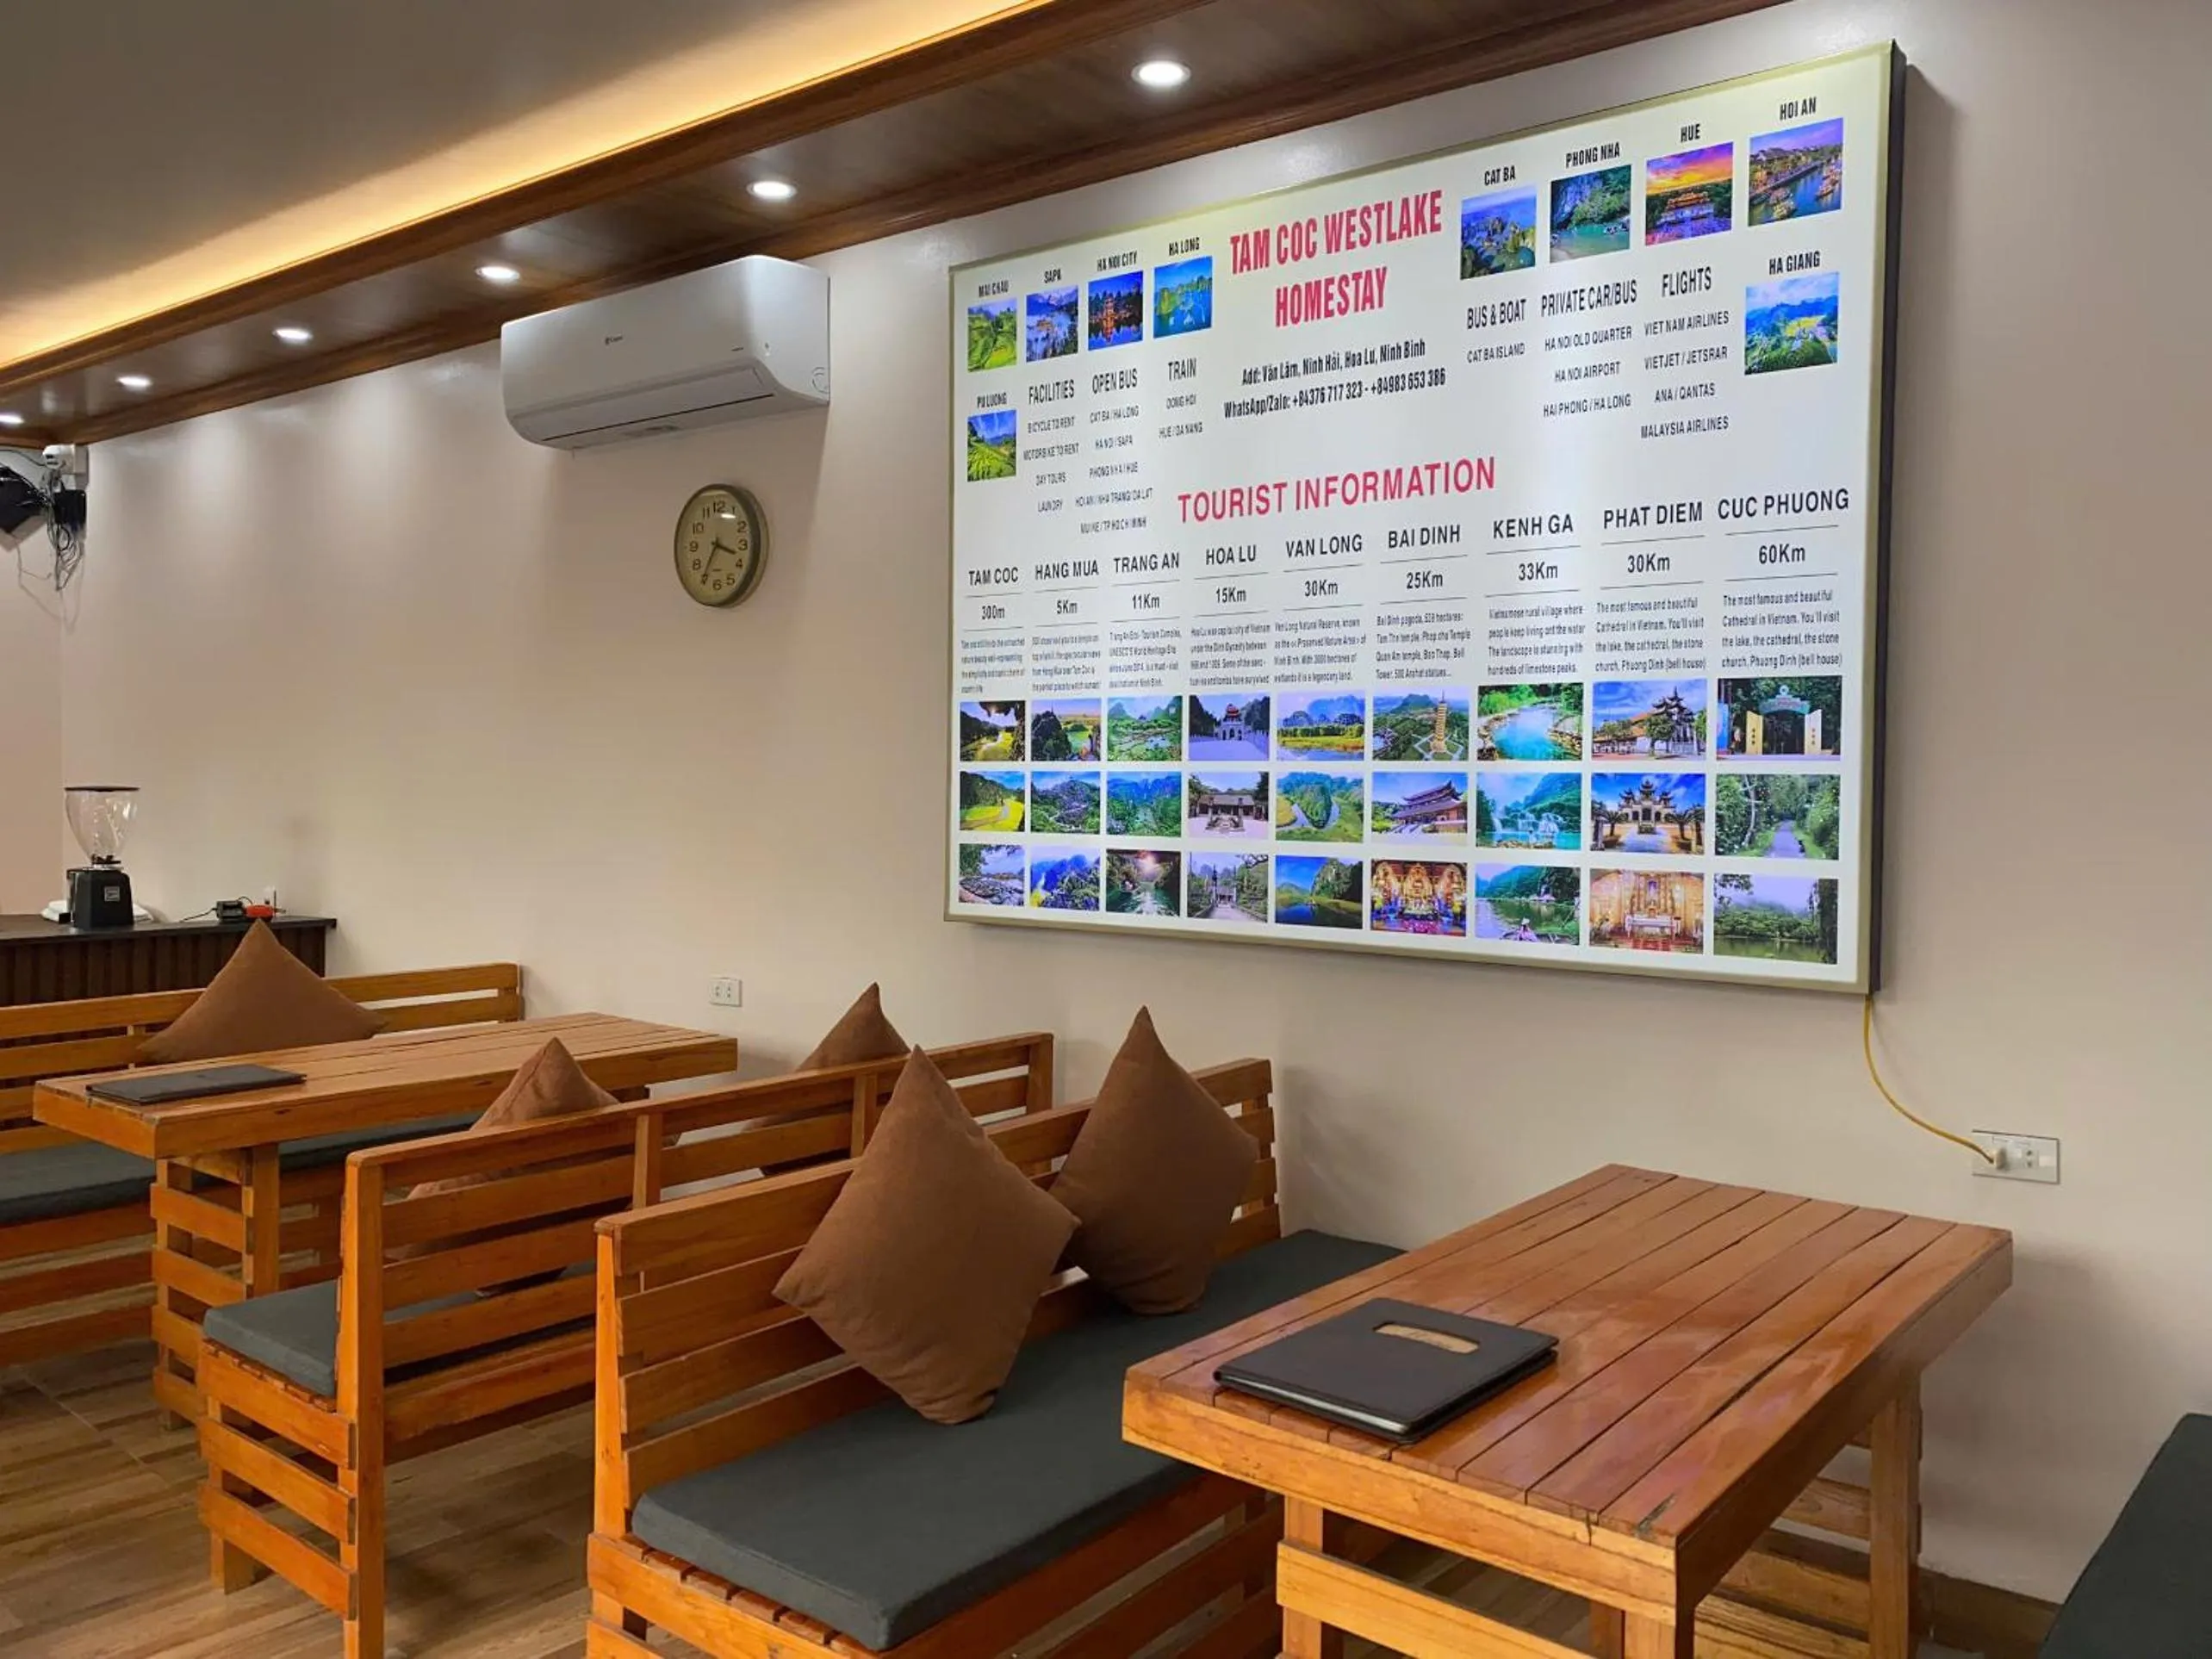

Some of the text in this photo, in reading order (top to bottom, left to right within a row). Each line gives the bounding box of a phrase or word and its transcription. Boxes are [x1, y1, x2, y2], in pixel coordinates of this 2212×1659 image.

[1780, 97, 1817, 121] HOI AN
[1681, 123, 1700, 143] HUE
[1566, 141, 1620, 169] PHONG NHA
[1484, 165, 1516, 187] CAT BA
[1229, 190, 1443, 275] TAM COC WESTLAKE
[1180, 236, 1200, 254] LONG
[1768, 250, 1820, 275] HA GIANG
[1662, 266, 1712, 298] FLIGHTS
[1275, 266, 1388, 328] HOMESTAY
[1541, 279, 1637, 318] PRIVATE CAR/BUS
[1467, 298, 1527, 330] BUS & BOAT
[1644, 310, 1729, 337] VIET NAM AIRLINES
[1544, 337, 1556, 351] HA
[1573, 332, 1591, 347] OLD
[1592, 326, 1632, 345] QUARTER
[1303, 355, 1323, 376] Ninh
[1345, 351, 1362, 369] Hoa
[1380, 342, 1401, 363] Ninh
[1467, 342, 1525, 363] CAT BA ISLAND
[1644, 351, 1680, 370] VIETJET
[1168, 357, 1196, 382] TRAIN
[1583, 360, 1620, 378] AIRPORT
[1028, 379, 1075, 405] FACILITIES
[1092, 368, 1138, 395] OPEN BUS
[1224, 367, 1445, 419] WhatsApp/Zalo: +84376 717 323 +84983 653 386
[1654, 382, 1715, 404] ANA QANTAS
[1543, 404, 1557, 418] HAI
[1558, 398, 1588, 416] PHONG
[1606, 392, 1631, 410] LONG
[1641, 415, 1729, 439] MALAYSIA AIRLINES
[1177, 456, 1494, 524] TOURIST INFORMATION
[703, 506, 711, 519] 11
[713, 500, 726, 513] 12
[1718, 488, 1849, 520] CUC PHUONG
[737, 520, 747, 533] 2
[1493, 514, 1574, 539] KENH GA
[1603, 501, 1703, 530] PHAT DIEM
[693, 522, 705, 535] 10
[1389, 525, 1461, 550] BAI DINH
[689, 540, 699, 553] 9
[738, 538, 749, 551] 3
[1206, 544, 1257, 566] HOA LU
[1286, 534, 1363, 559] VAN LONG
[1759, 544, 1806, 565] 60Km
[693, 558, 701, 571] 8
[736, 558, 743, 569] 4
[1035, 559, 1099, 581] HANG MUA
[1113, 552, 1179, 574] TRANG AN
[1518, 561, 1558, 581] 33Km
[1627, 553, 1670, 574] 30Km
[712, 579, 722, 591] 6
[726, 573, 736, 586] 5
[969, 567, 1018, 586] TAM COC
[1406, 571, 1444, 590] 25Km
[1215, 587, 1246, 604] 15Km
[1304, 580, 1339, 597] 30Km
[981, 605, 1005, 620] 300m
[1057, 600, 1078, 615] 5Km
[1132, 593, 1159, 610] 11Km
